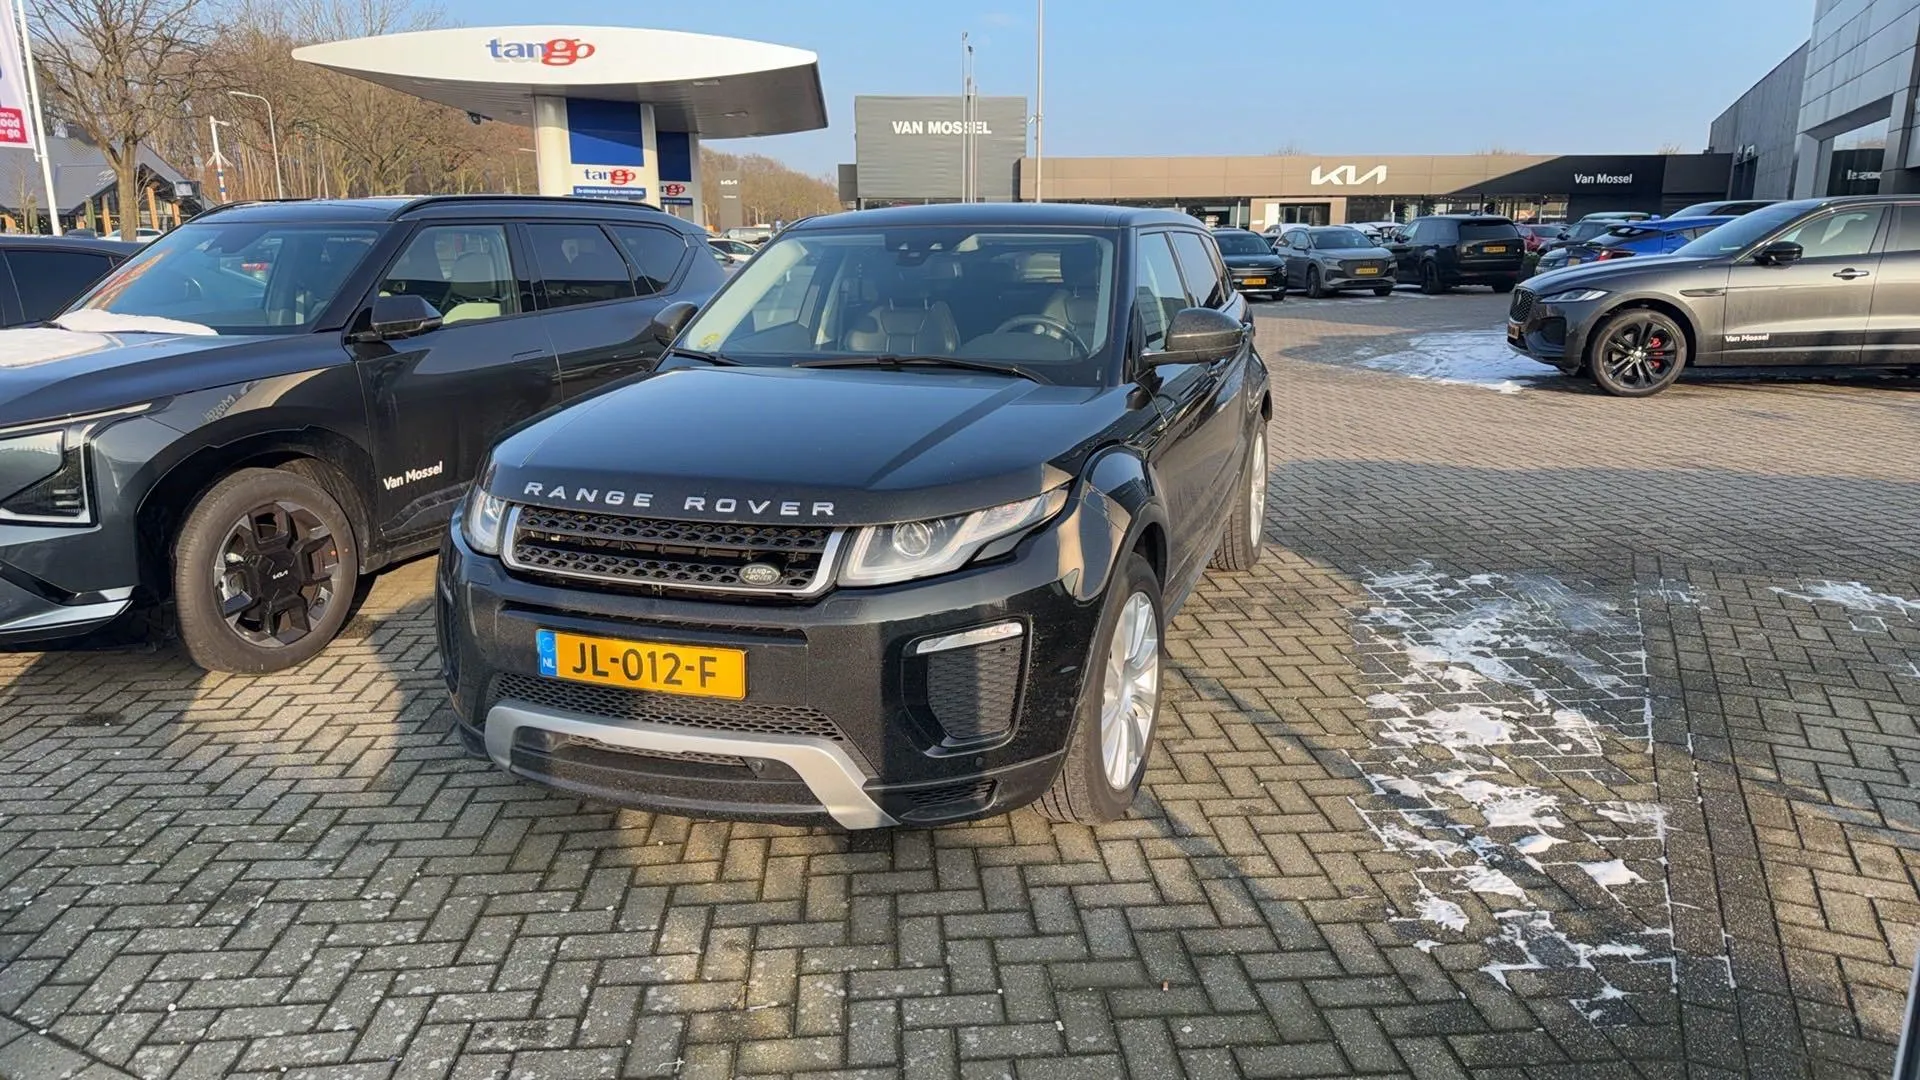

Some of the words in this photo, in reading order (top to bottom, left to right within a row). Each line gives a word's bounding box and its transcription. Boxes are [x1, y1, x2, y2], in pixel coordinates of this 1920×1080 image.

[485, 38, 595, 66] tango
[0, 118, 20, 128] ood
[892, 121, 924, 134] VAN
[584, 168, 636, 185] tango
[1310, 165, 1387, 185] KIA
[1574, 173, 1595, 184] Van
[1596, 173, 1633, 184] Mossel
[661, 184, 686, 197] ngo
[1741, 333, 1769, 342] Mossel
[383, 476, 404, 490] Van
[405, 460, 443, 484] Mossel
[523, 481, 654, 508] RANGE
[683, 496, 835, 517] ROVER
[542, 656, 555, 669] NL
[572, 642, 717, 688] JL-012-F
